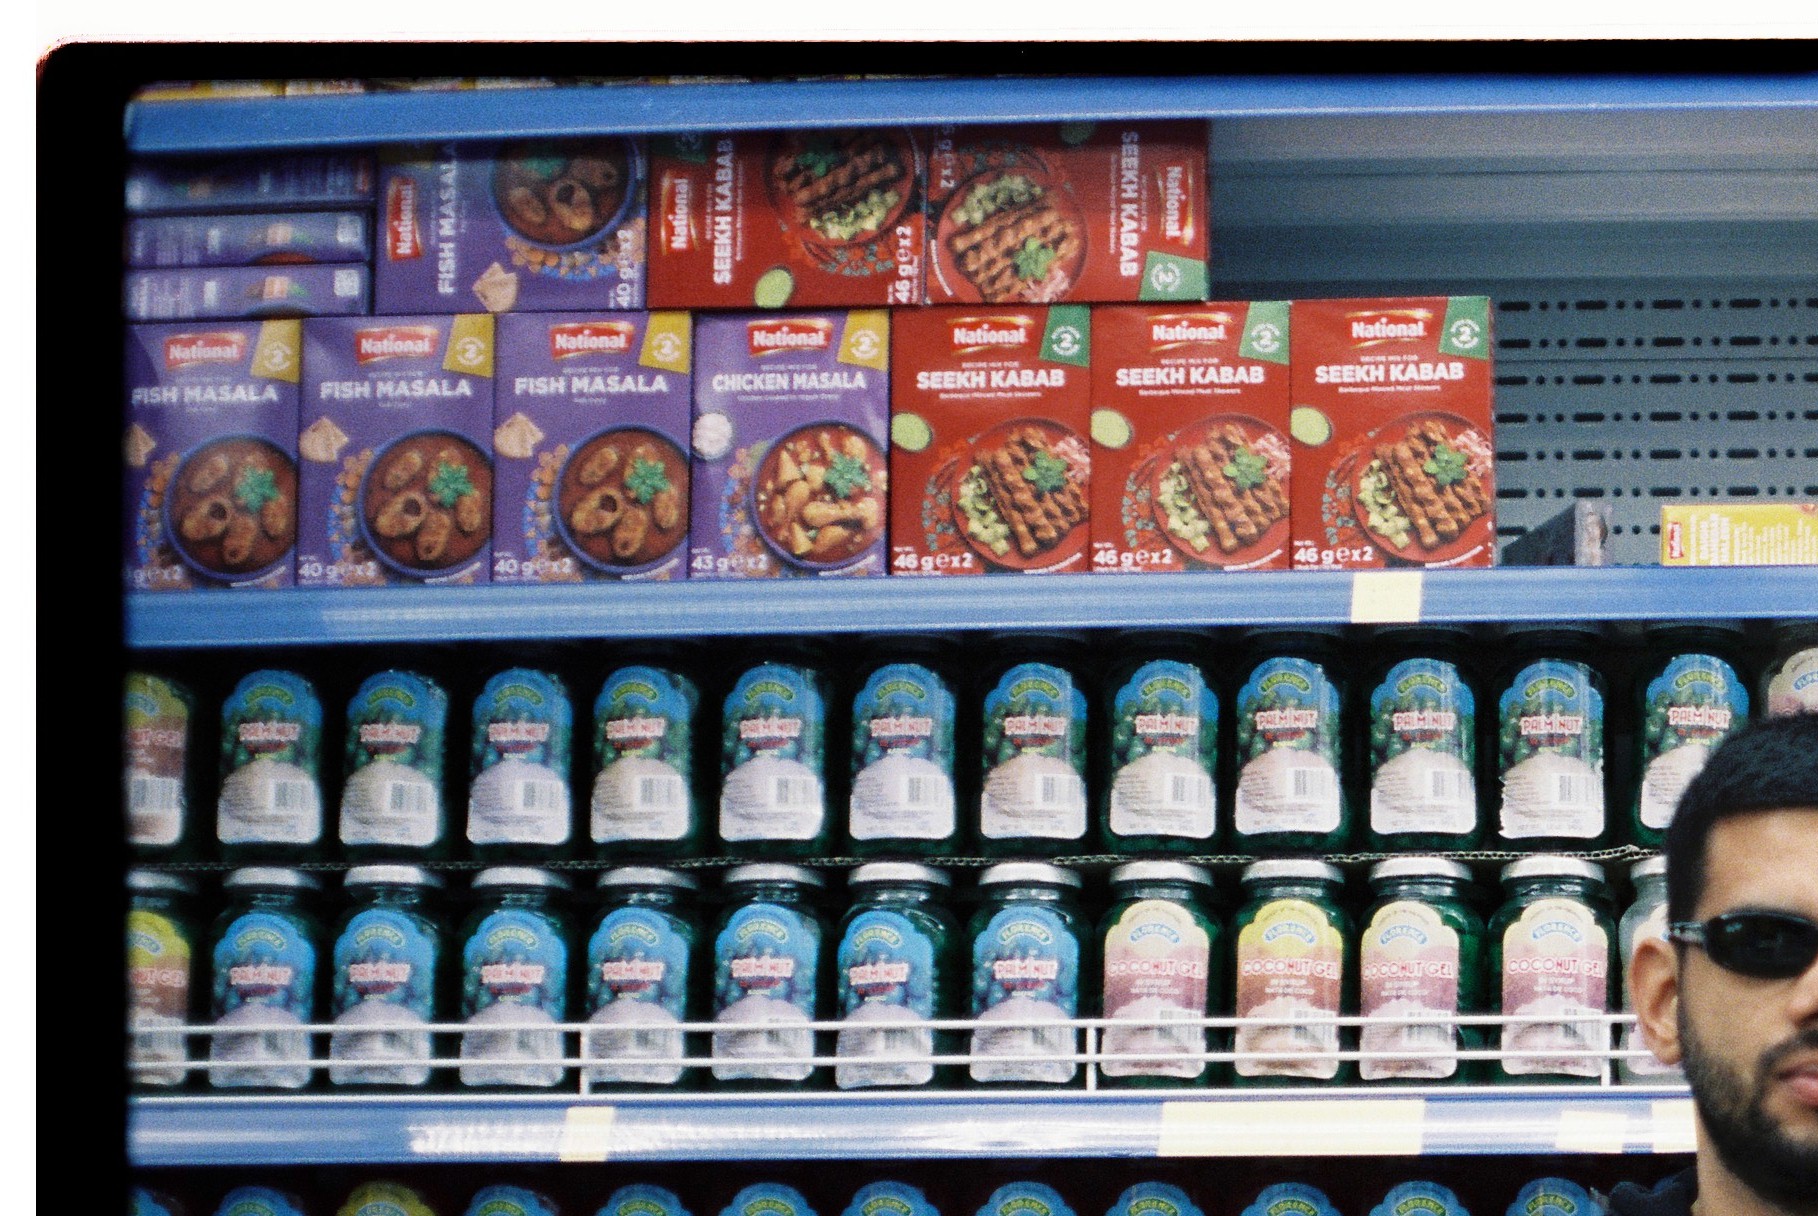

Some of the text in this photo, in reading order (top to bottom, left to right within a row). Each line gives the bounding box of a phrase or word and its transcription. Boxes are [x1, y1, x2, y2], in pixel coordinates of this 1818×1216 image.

[713, 139, 733, 284] SEEKH KABAB
[1120, 131, 1139, 276] SEEKH KABAB
[1166, 166, 1182, 237] National
[671, 179, 688, 249] National
[438, 242, 455, 295] FISH
[753, 326, 827, 347] National
[954, 322, 1026, 344] National
[1152, 320, 1226, 341] National
[1352, 317, 1426, 338] National
[170, 340, 237, 360] National
[361, 334, 429, 356] National
[555, 329, 626, 350] National
[712, 371, 865, 391] CHICKEN MASALA
[917, 369, 1065, 390] SEEKH KABAB
[1116, 366, 1264, 386] SEEKH KABAB
[1315, 362, 1465, 384] SEEKH KABAB
[184, 385, 277, 403] MASALA
[321, 380, 470, 399] FISH MASALA
[514, 374, 669, 395] FISH MASALA
[1521, 715, 1581, 735] PALM NUT
[1669, 706, 1730, 728] PALM NUT
[1243, 958, 1339, 981] COCONUT GEL
[1364, 959, 1453, 979] COCONUT GEL
[1508, 958, 1605, 979] COCONUT GEL
